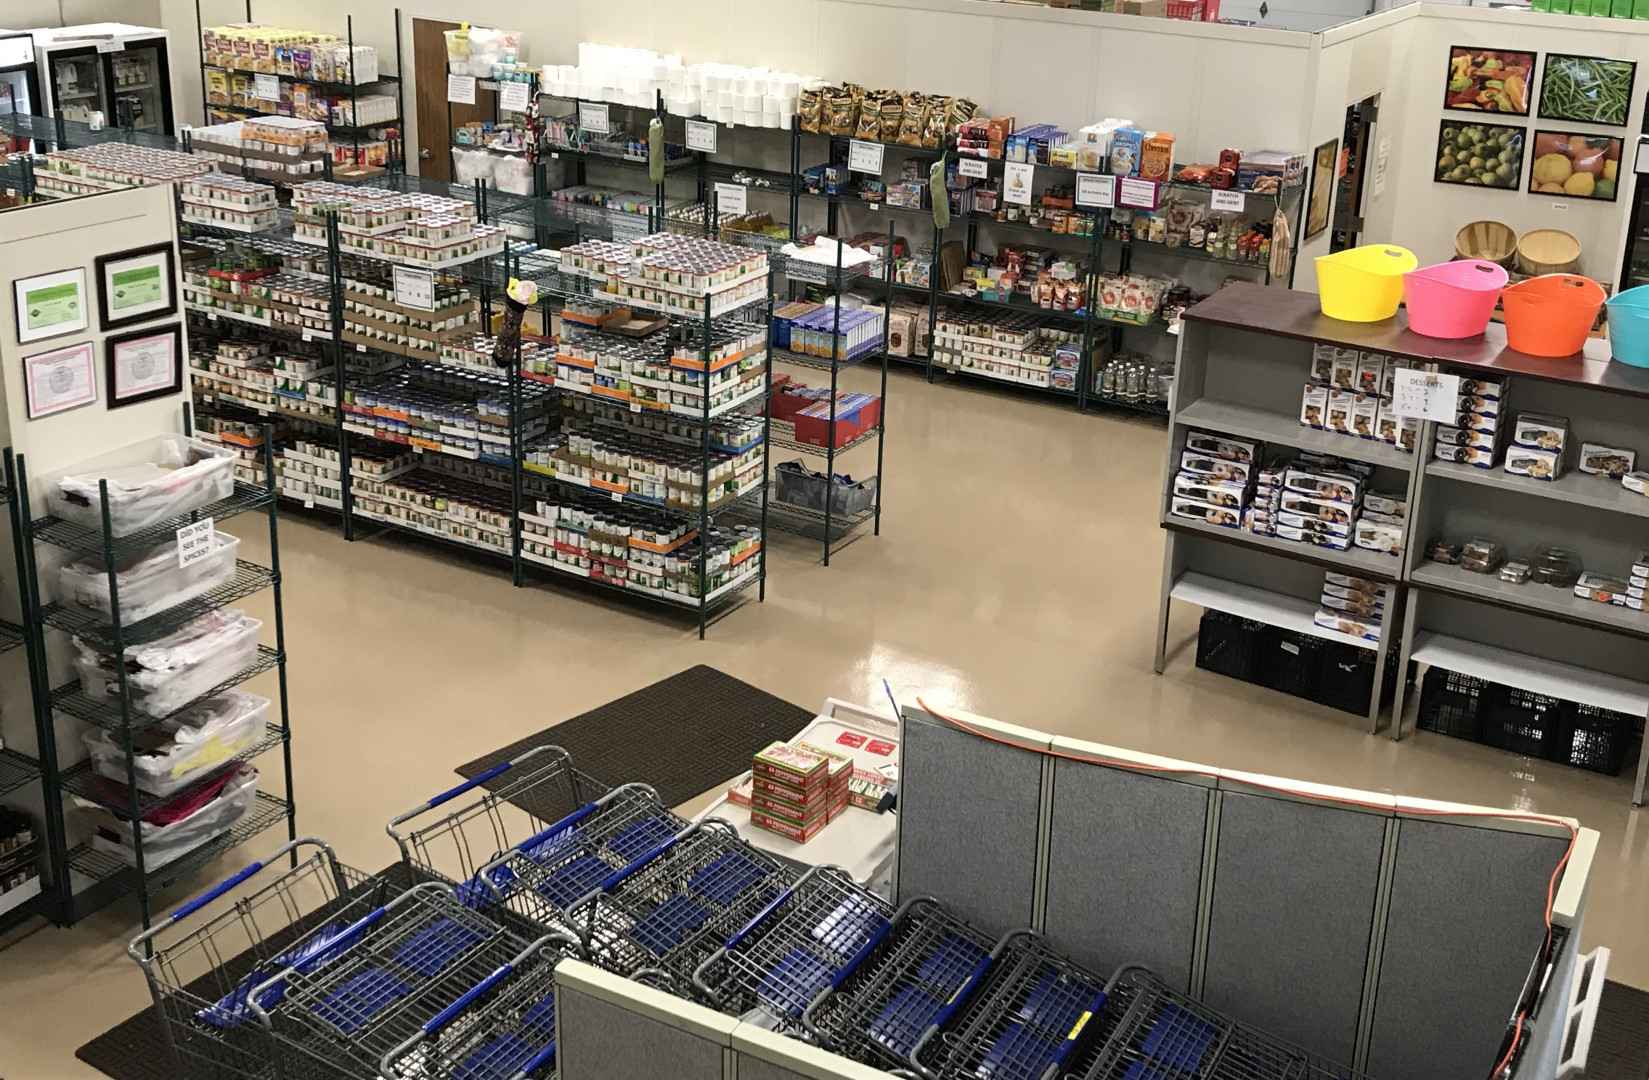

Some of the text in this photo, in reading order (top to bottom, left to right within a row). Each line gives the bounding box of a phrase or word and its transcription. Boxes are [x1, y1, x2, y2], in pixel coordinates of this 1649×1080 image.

[1410, 378, 1443, 389] DESSERTS
[180, 522, 209, 538] DID YOU
[183, 534, 209, 550] SEE THE
[184, 546, 209, 562] SPICES?
[775, 769, 804, 782] PEPPERMINT
[774, 786, 804, 800] PEPPERMINT
[773, 803, 803, 817] PEPPERMINT
[772, 820, 802, 835] PEPPERMINT
